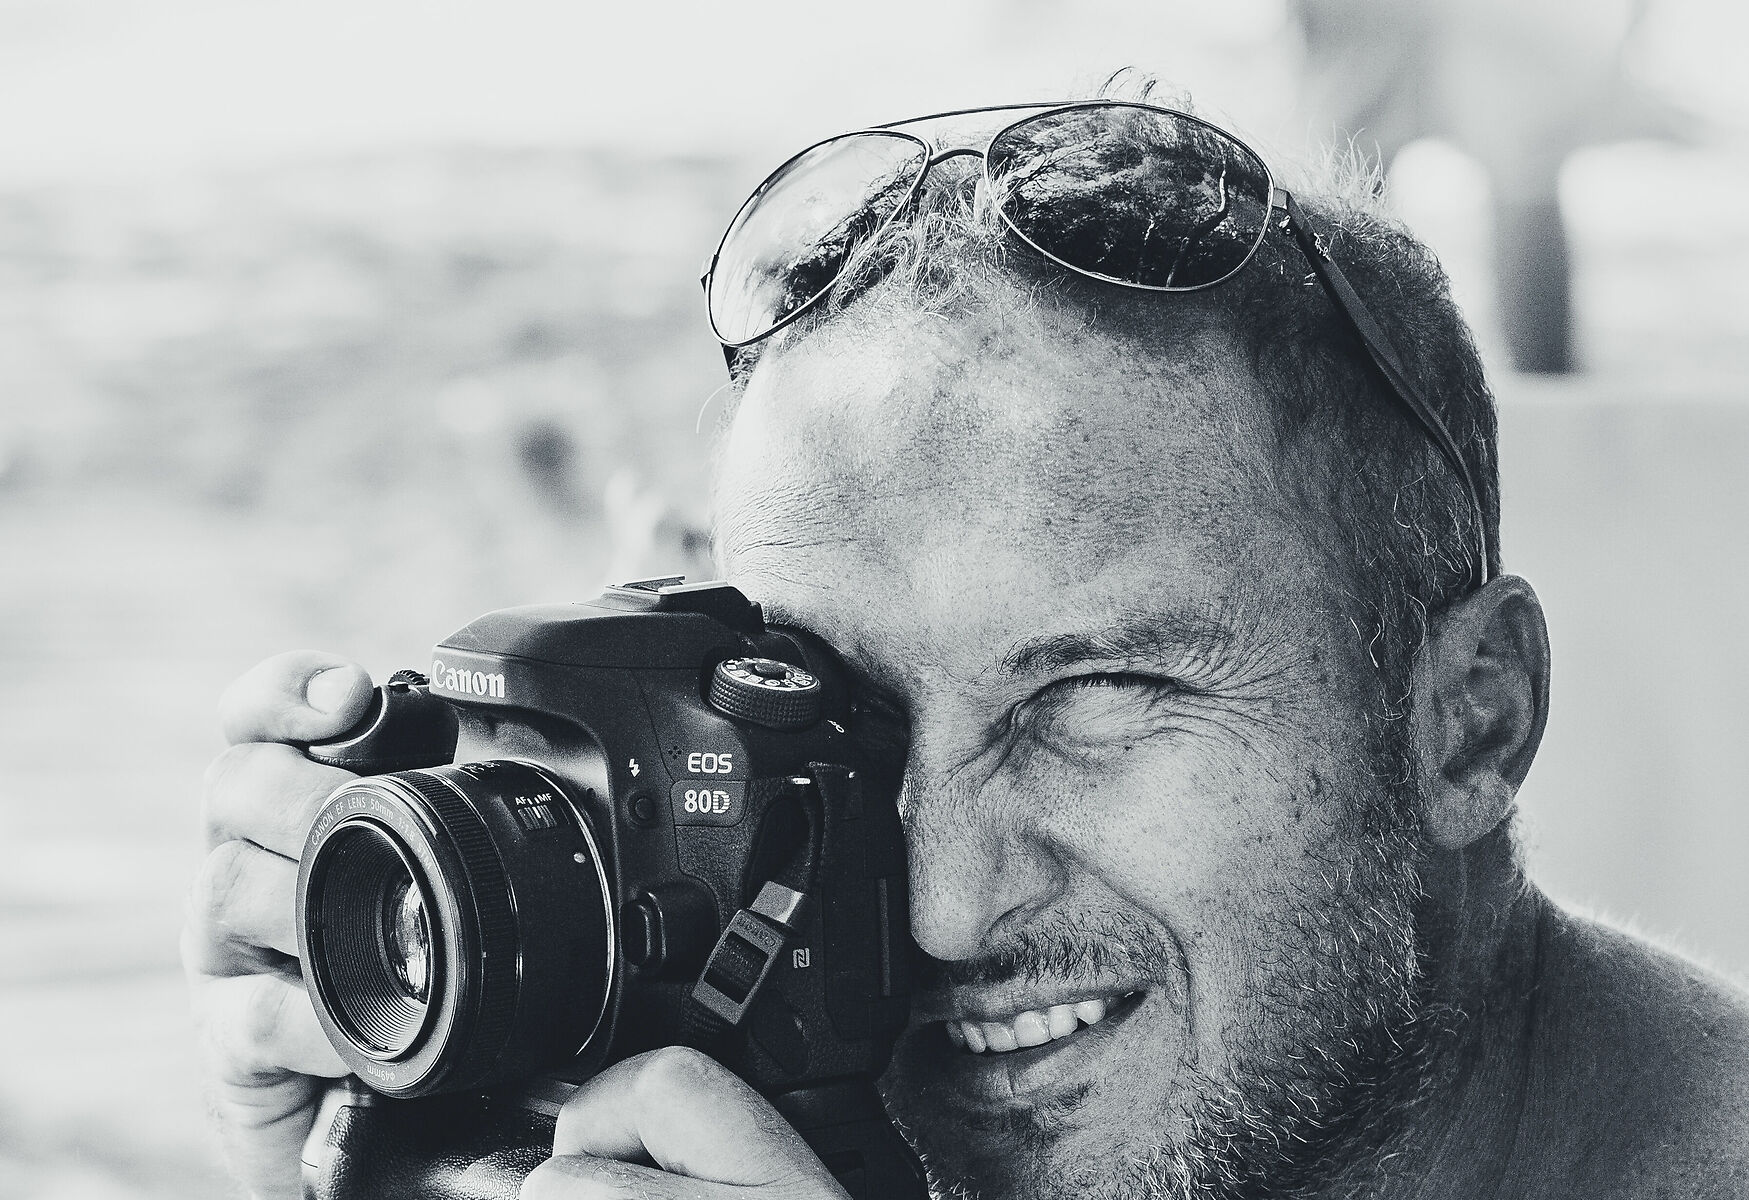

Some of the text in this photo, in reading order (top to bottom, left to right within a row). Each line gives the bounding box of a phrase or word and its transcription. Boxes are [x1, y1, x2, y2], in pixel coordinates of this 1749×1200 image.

[432, 659, 505, 698] Canon
[687, 752, 733, 774] EOS
[515, 793, 552, 806] AF MF
[684, 789, 731, 814] 80D
[311, 810, 334, 846] CANON
[336, 801, 345, 816] EF
[347, 796, 367, 810] LENS
[371, 798, 394, 820] 50mm
